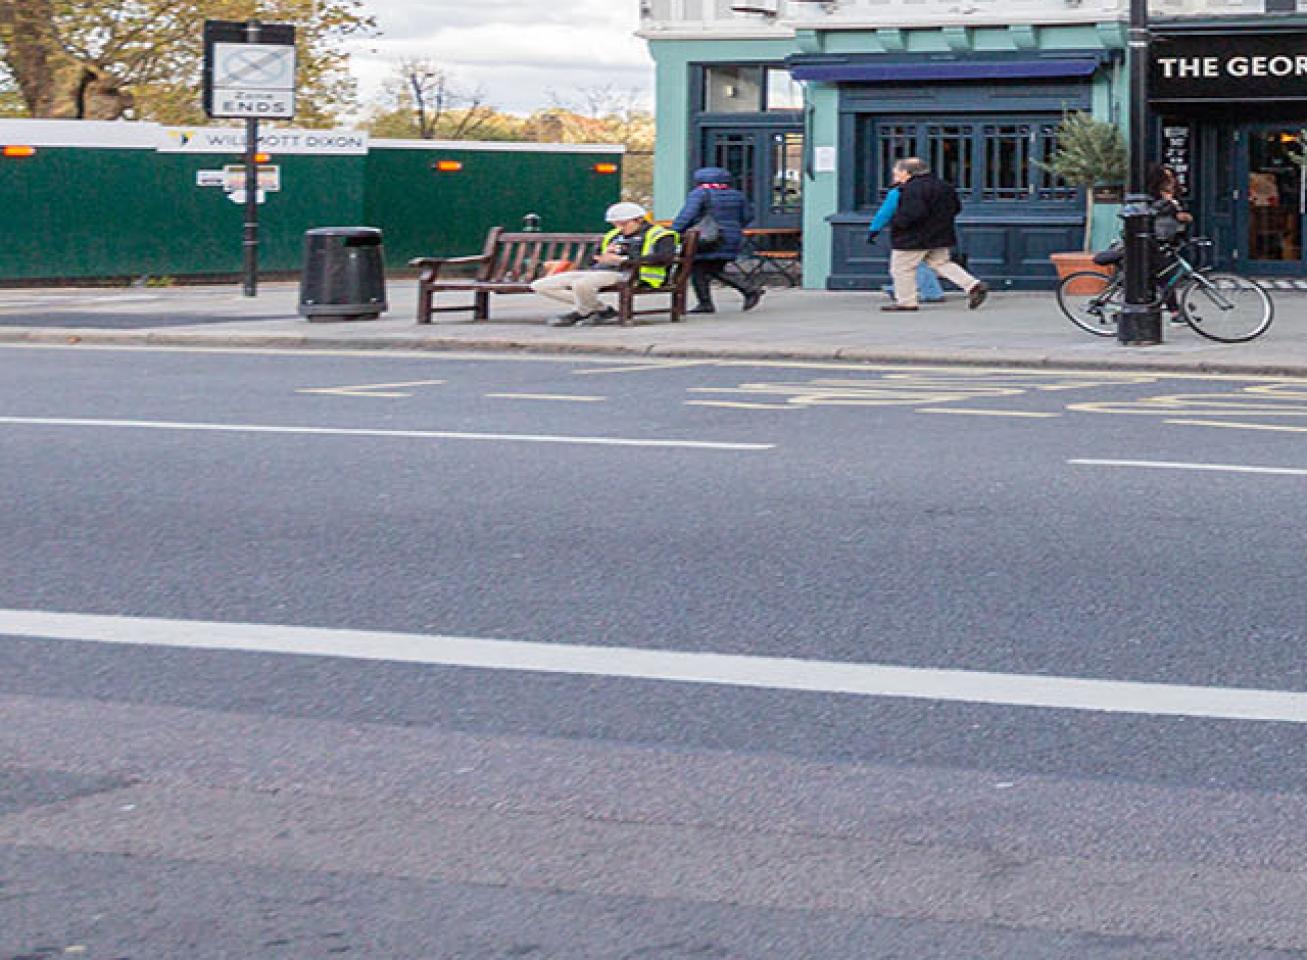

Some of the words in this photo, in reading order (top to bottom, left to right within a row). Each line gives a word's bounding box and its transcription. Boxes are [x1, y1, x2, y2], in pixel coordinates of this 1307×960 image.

[1158, 56, 1219, 78] THE
[222, 101, 286, 113] ENDS
[305, 136, 363, 147] DIXON
